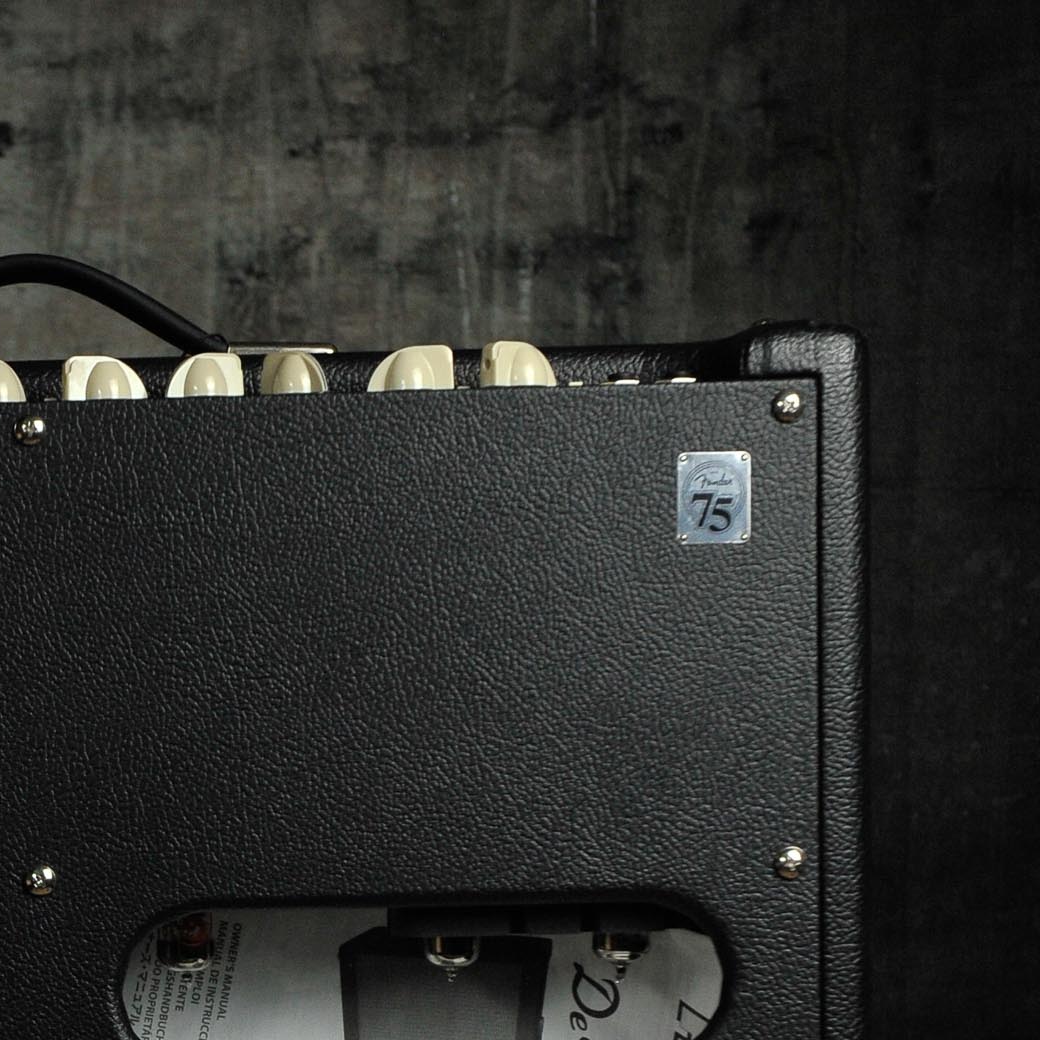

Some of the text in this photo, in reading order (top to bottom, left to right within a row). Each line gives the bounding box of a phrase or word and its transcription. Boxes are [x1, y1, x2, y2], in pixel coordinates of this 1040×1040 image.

[691, 492, 734, 532] 75
[214, 920, 228, 968] MANUAL
[208, 969, 220, 984] DE
[216, 922, 242, 1021] OWNER'S MANUAL
